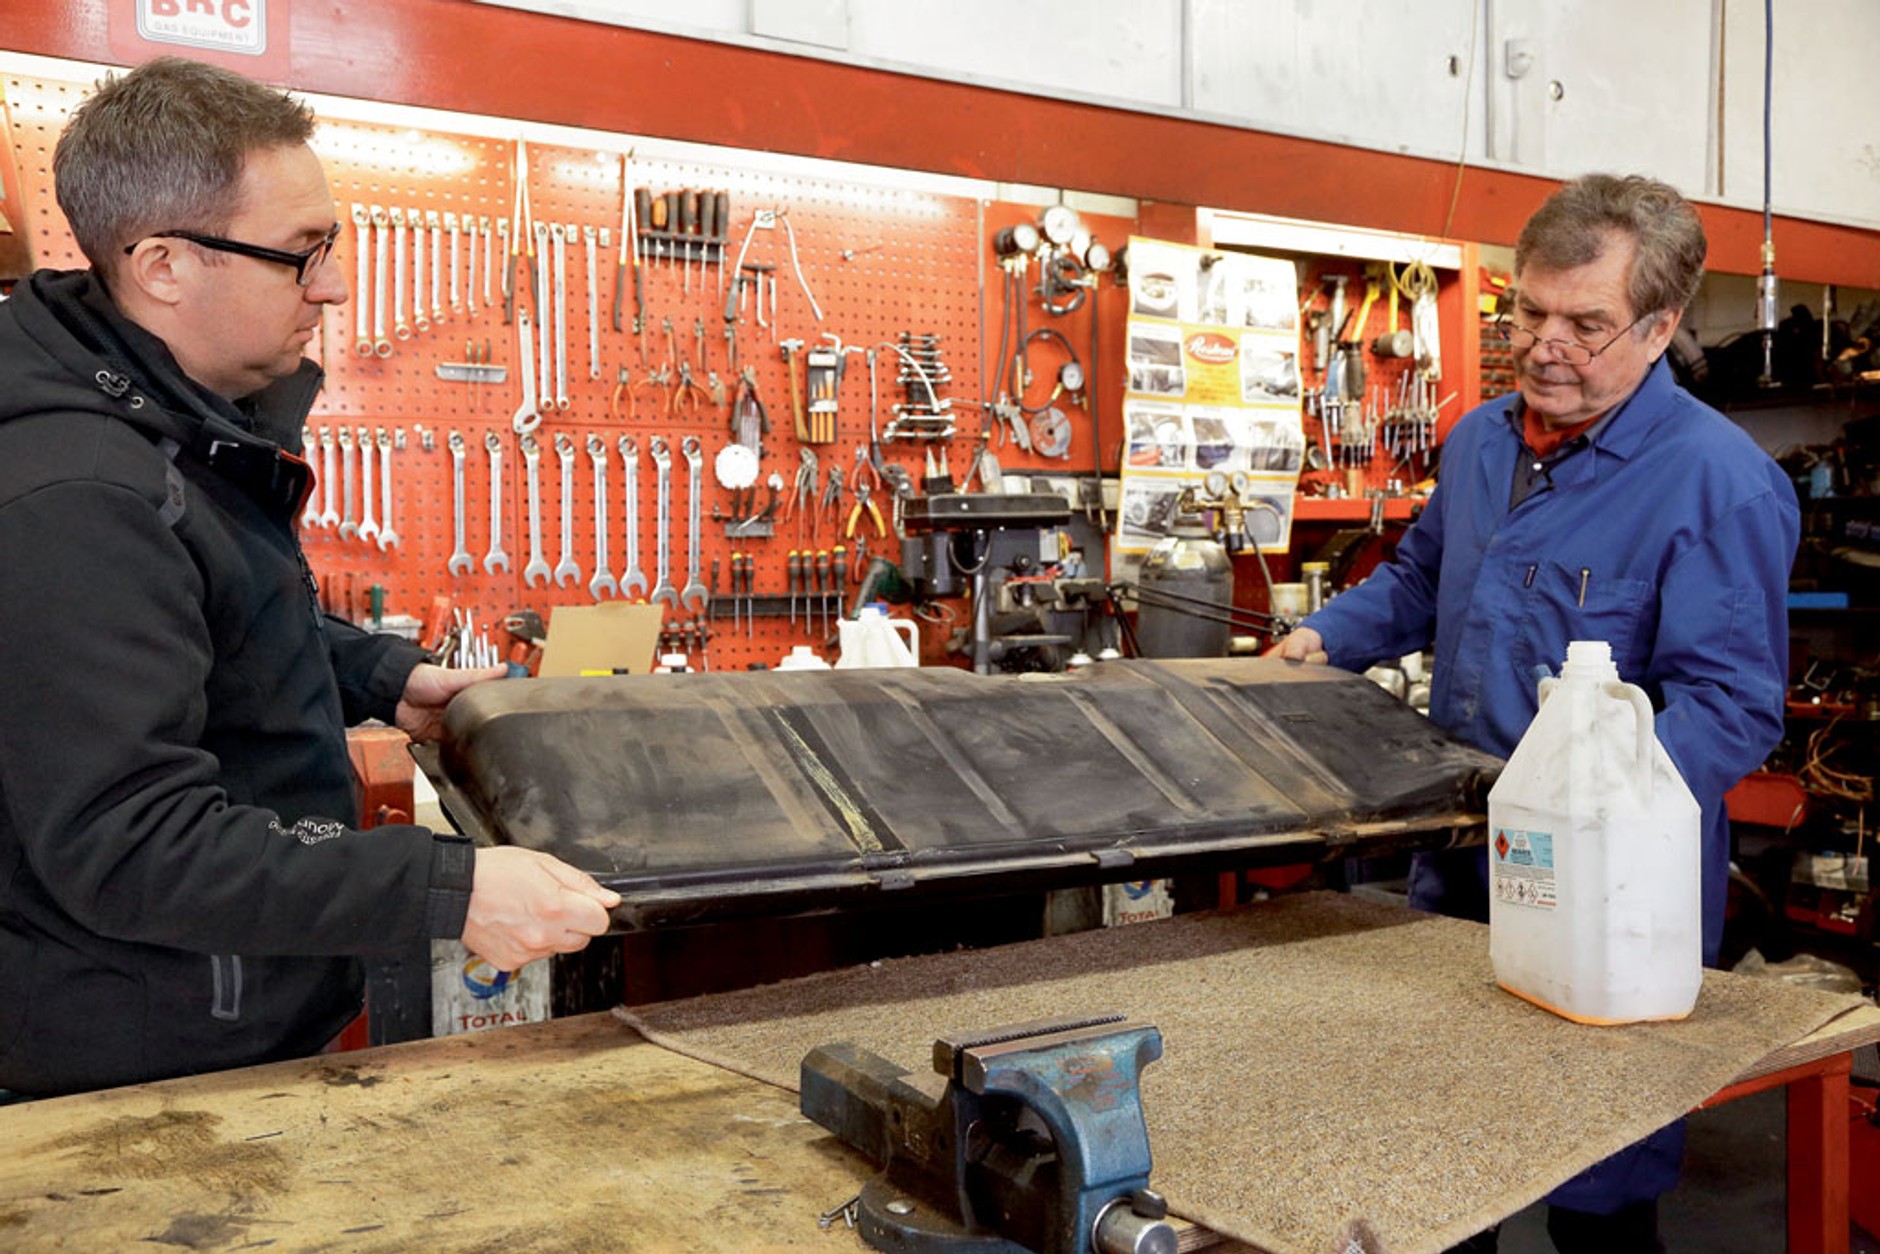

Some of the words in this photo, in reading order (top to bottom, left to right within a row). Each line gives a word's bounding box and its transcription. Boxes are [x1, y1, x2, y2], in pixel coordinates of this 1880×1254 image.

[154, 20, 178, 32] GAS
[182, 25, 249, 42] EQUIPMENT
[459, 1010, 528, 1030] TOTAL
